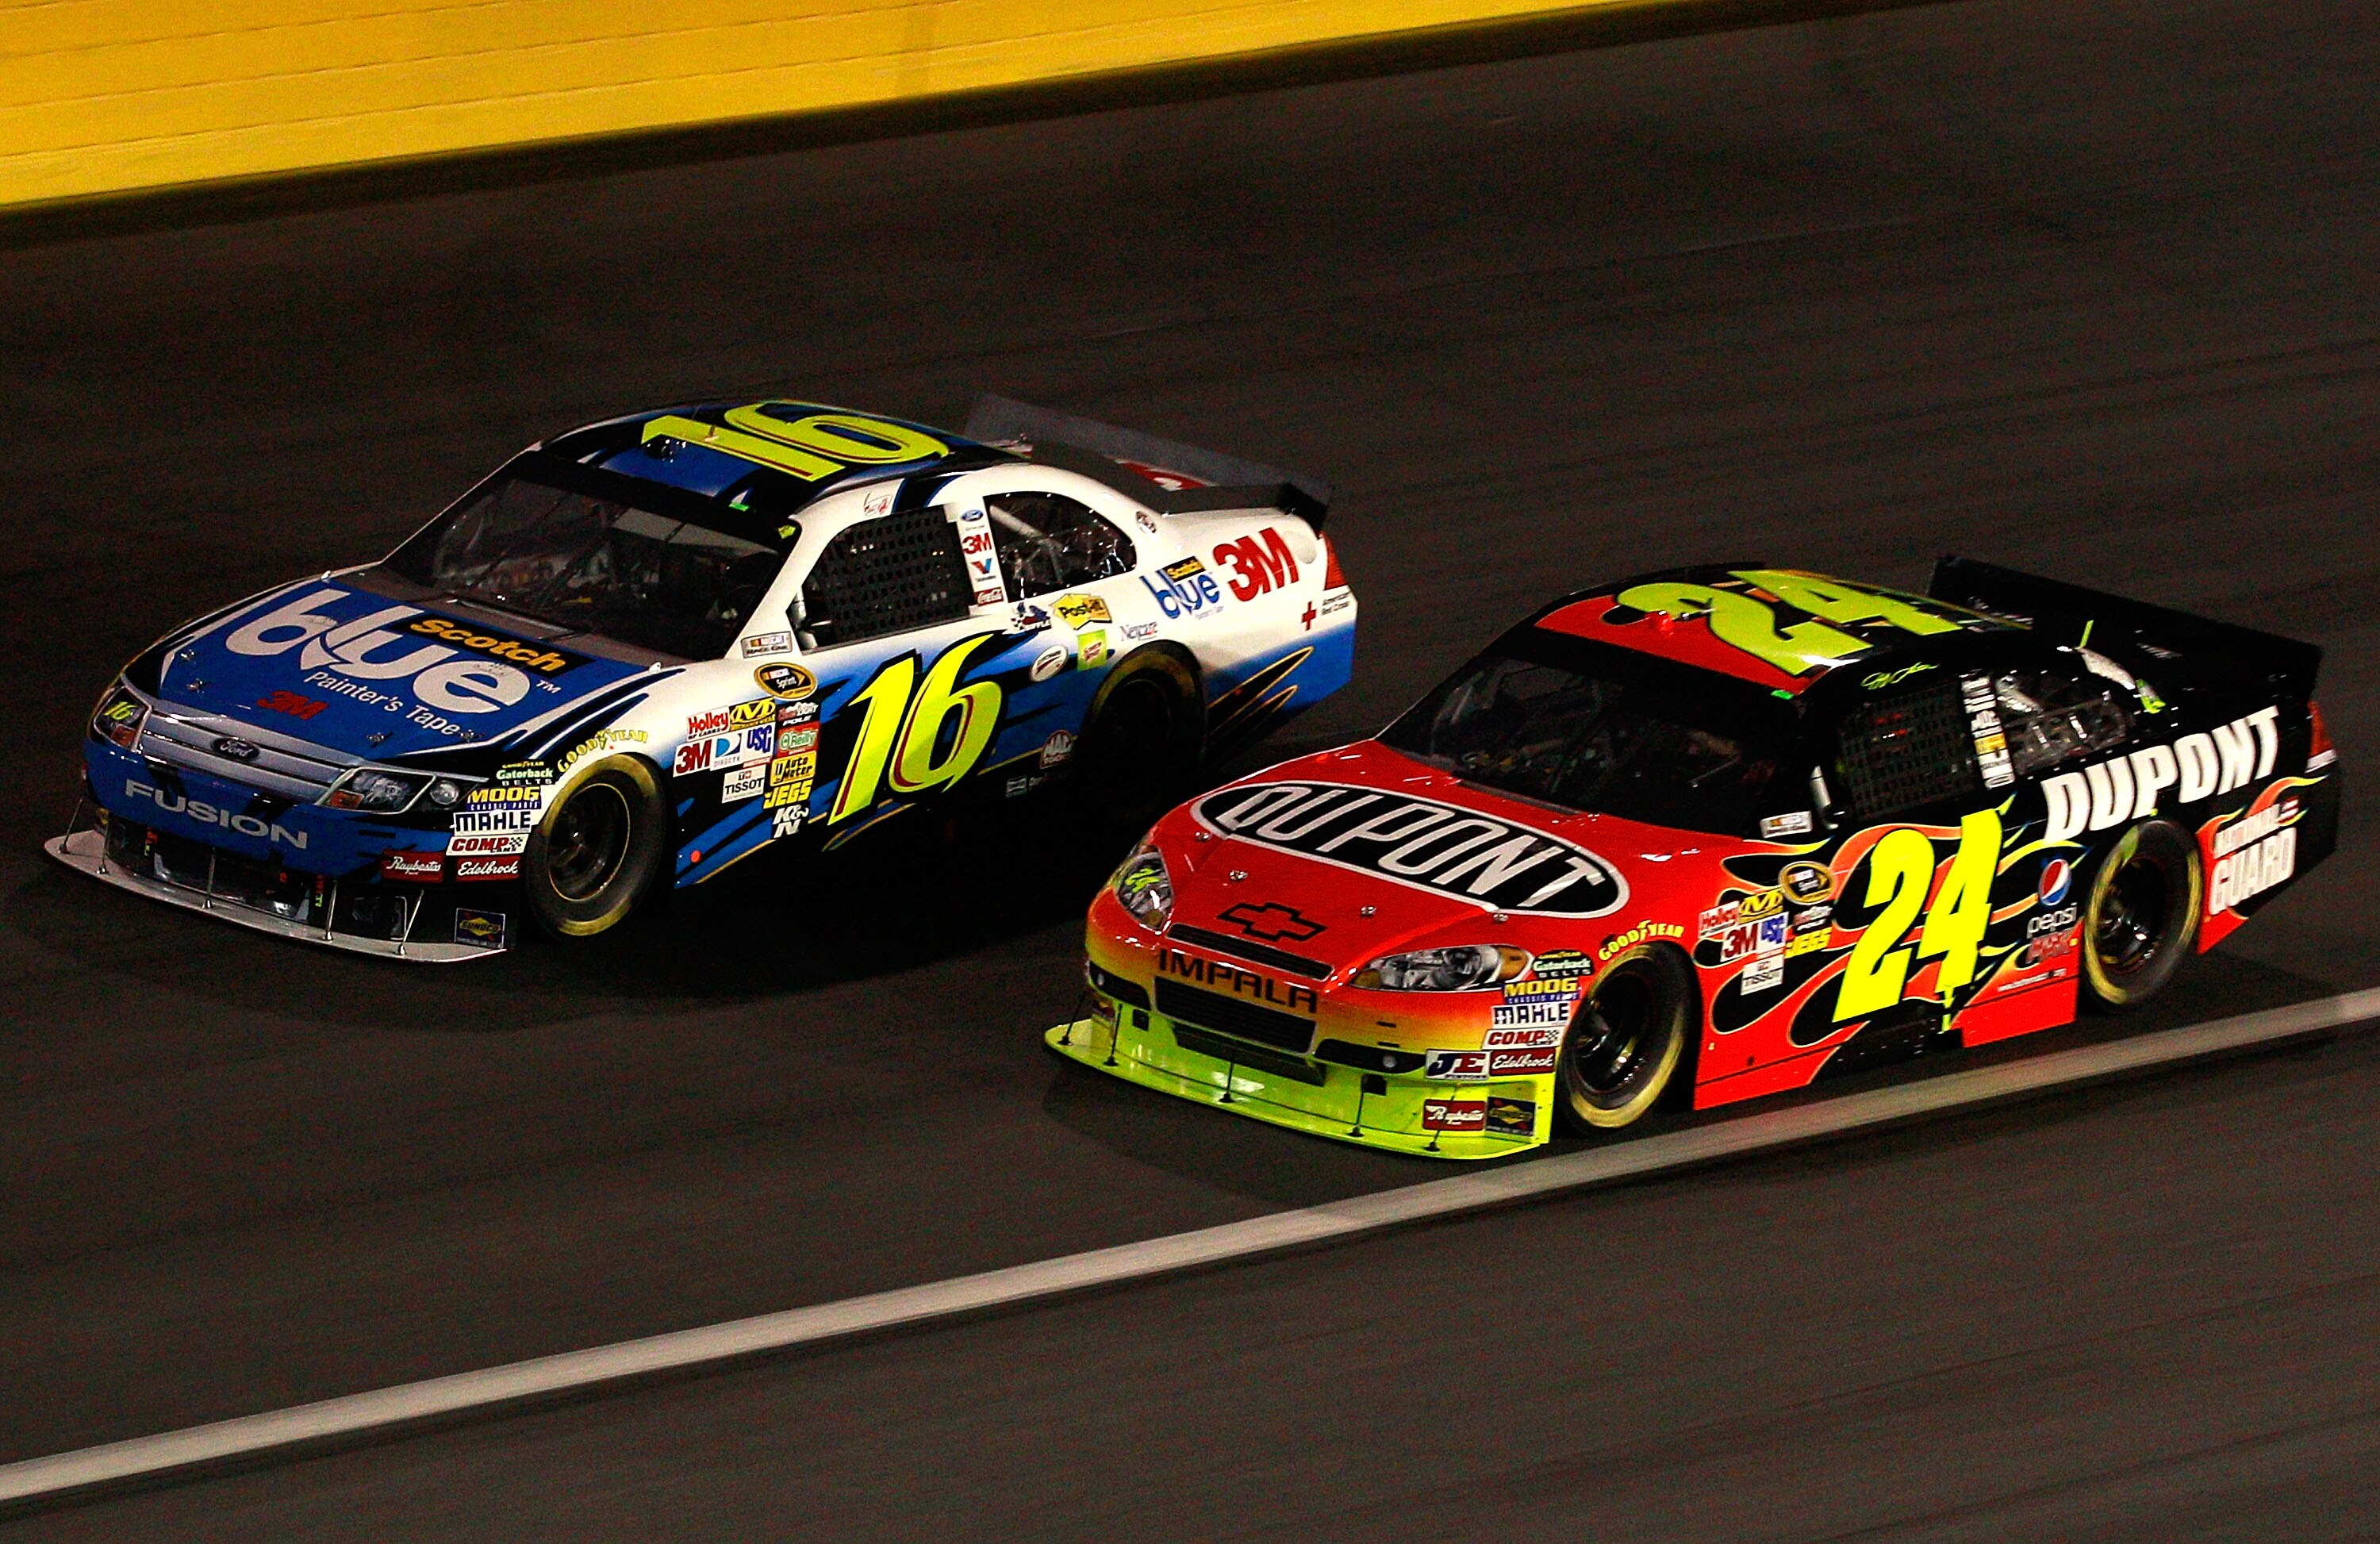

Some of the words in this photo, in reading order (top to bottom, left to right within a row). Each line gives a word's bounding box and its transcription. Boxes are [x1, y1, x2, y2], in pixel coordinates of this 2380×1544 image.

[641, 399, 950, 482] 16
[962, 532, 992, 555] 3M
[1212, 527, 1299, 602] 3M
[1138, 569, 1220, 620] blue
[1616, 570, 1963, 675] 24
[225, 589, 532, 713] blue
[410, 617, 566, 672] Scotch
[257, 689, 329, 720] 3M
[303, 671, 403, 712] Painter's
[404, 704, 461, 737] Tape
[688, 712, 729, 735] Holley
[827, 633, 1002, 825] 16
[220, 740, 254, 758] Ford
[557, 728, 649, 773] GOODYEAR
[747, 725, 773, 754] USG
[675, 739, 712, 774] 3M
[785, 756, 808, 768] Auto
[496, 768, 554, 781] Gatorback
[784, 766, 813, 778] Meter
[2040, 705, 2279, 844] DUPONT
[467, 785, 541, 804] MOOG
[724, 778, 765, 794] TISSOT
[762, 778, 813, 809] JEGS
[125, 778, 309, 850] FUSION
[470, 801, 509, 812] CHASSIS
[455, 811, 532, 832] MAHLE
[451, 836, 510, 852] COMP
[386, 855, 442, 875] Raybestos
[457, 860, 520, 876] Edelbrock
[2209, 827, 2297, 916] GUARD
[459, 920, 501, 933] SUNOCO
[1832, 808, 2002, 1023] 24
[2026, 901, 2078, 939] pepsi
[1598, 920, 1684, 961] GOODYEAR
[1723, 923, 1760, 958] 3M
[1532, 958, 1592, 971] Gatorback
[1538, 969, 1591, 977] BELTS
[1158, 949, 1319, 1013] IMPALA
[1504, 977, 1579, 997] MOOG
[1507, 994, 1546, 1004] CHASSIS
[1493, 1002, 1570, 1024] MAHLE
[1488, 1030, 1547, 1045] COMP
[1427, 1053, 1487, 1076] JE
[1491, 1054, 1555, 1069] Edelbrock
